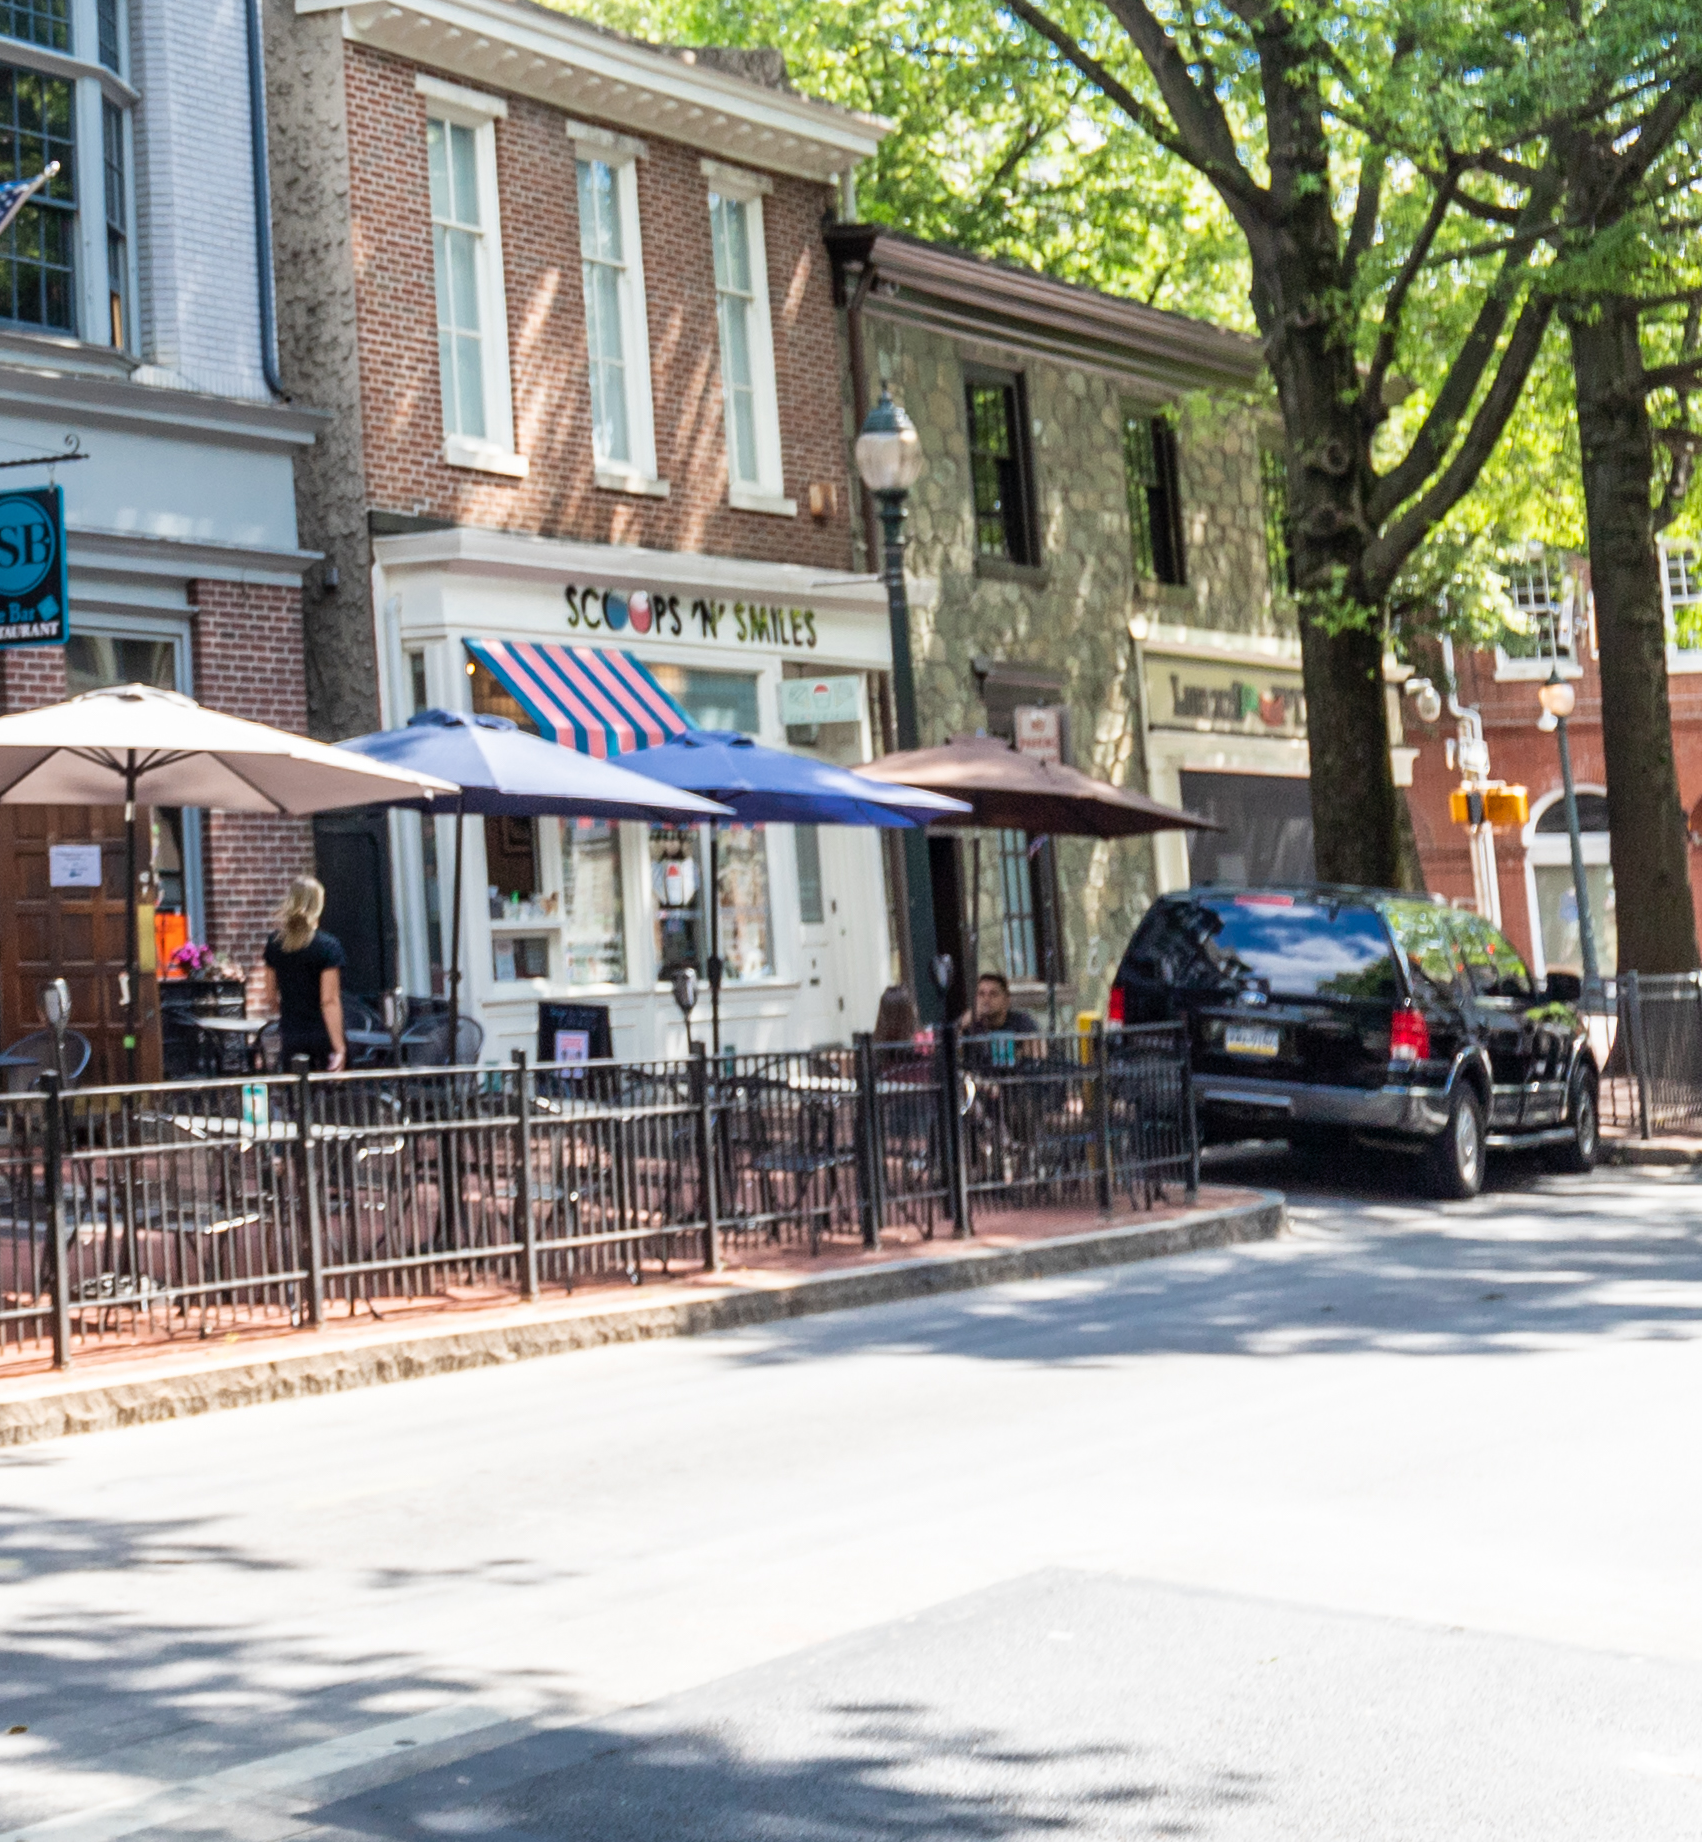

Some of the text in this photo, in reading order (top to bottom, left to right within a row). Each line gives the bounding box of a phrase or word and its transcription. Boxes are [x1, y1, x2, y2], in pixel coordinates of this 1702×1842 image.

[8, 602, 35, 623] Bar
[565, 585, 682, 637] SCOOPS
[734, 602, 817, 649] SMILES
